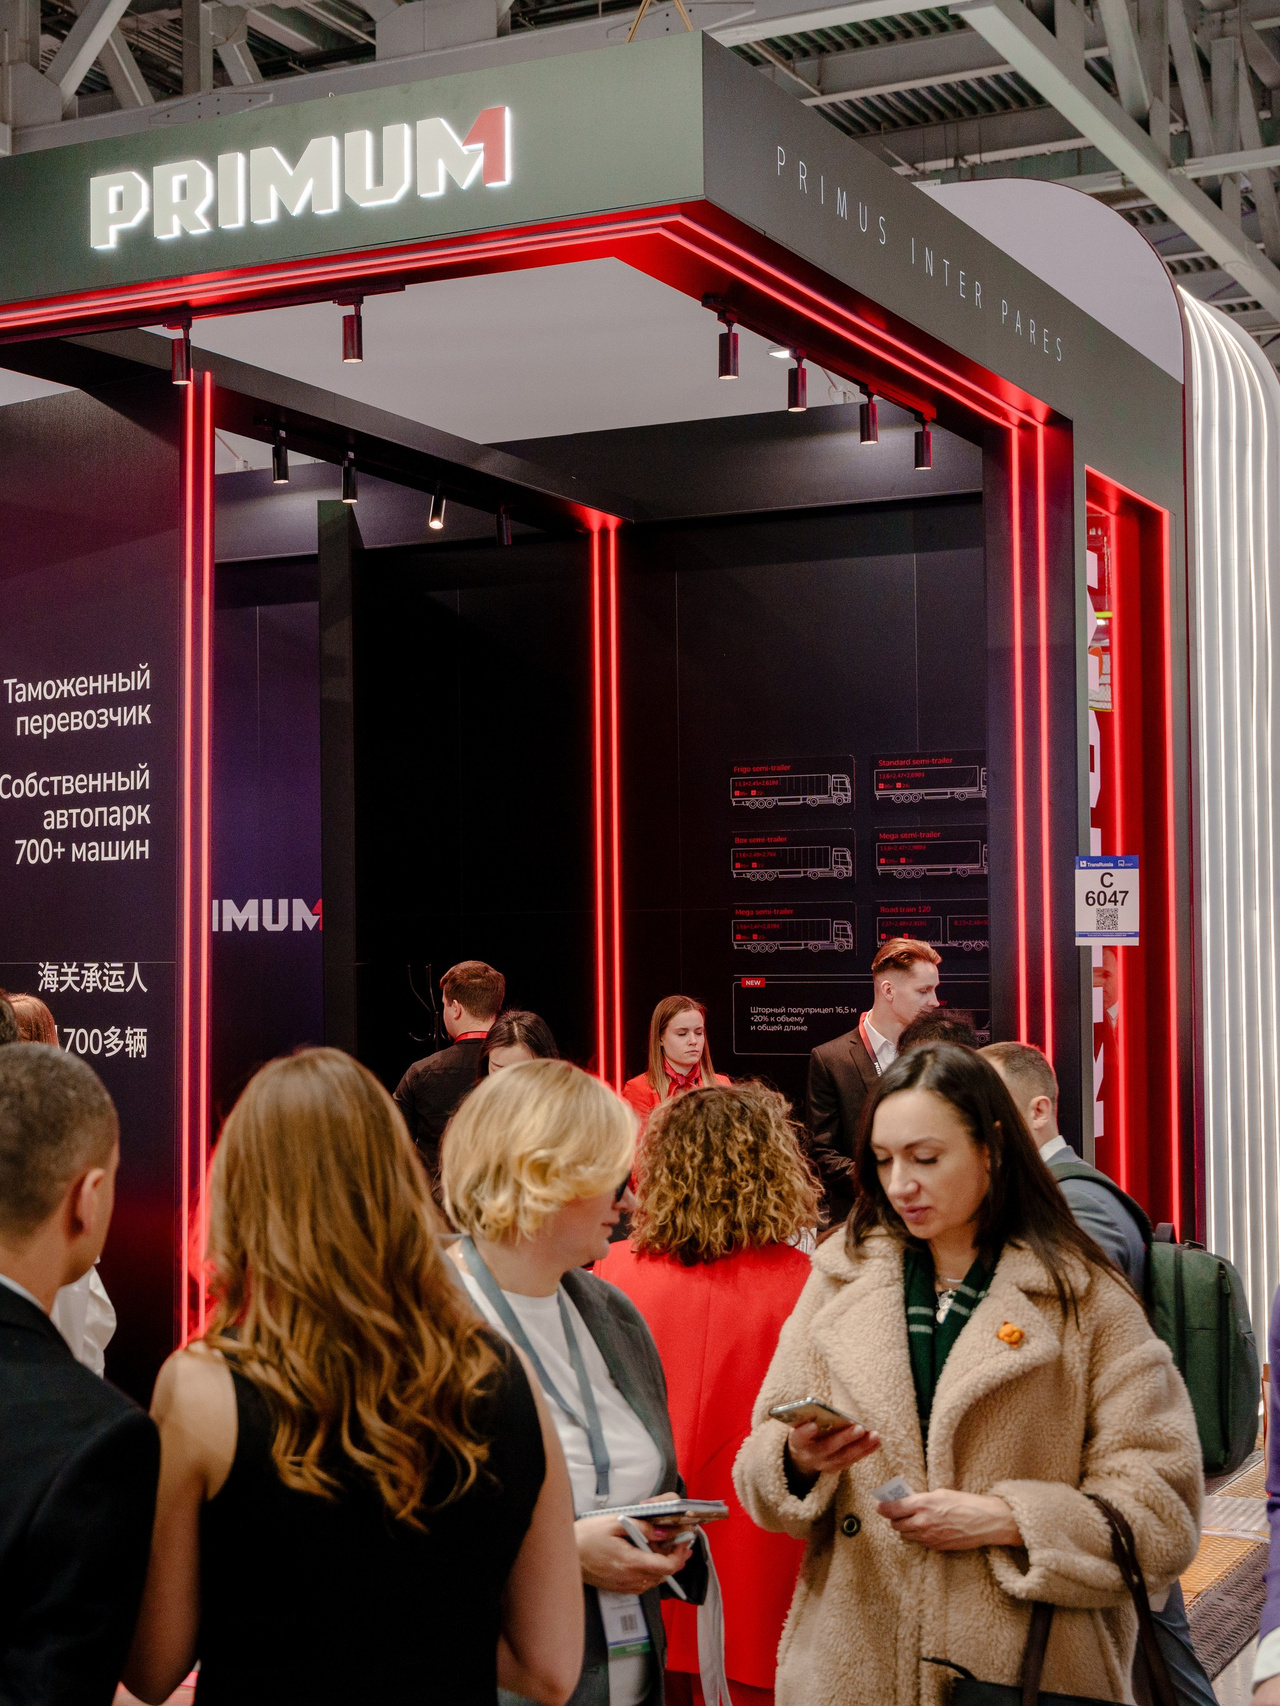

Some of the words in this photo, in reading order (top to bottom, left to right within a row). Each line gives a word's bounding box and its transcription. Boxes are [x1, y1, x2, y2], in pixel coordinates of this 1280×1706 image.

[89, 105, 513, 250] PRIMUM
[777, 146, 887, 245] PRIMUS
[911, 237, 983, 309] INTER
[1001, 300, 1063, 362] PARES
[3, 662, 151, 704] Таможенный
[16, 704, 152, 740] перевозчик
[43, 804, 151, 832] автопарк
[15, 838, 66, 865] 700+
[71, 839, 149, 863] машин
[1085, 890, 1129, 907] 6047
[212, 898, 323, 932] IMUM
[38, 962, 148, 993] 海关承运人
[750, 1015, 769, 1023] +20%
[776, 1015, 805, 1024] объему
[757, 1024, 783, 1032] общей
[55, 1025, 148, 1058] 700多辆
